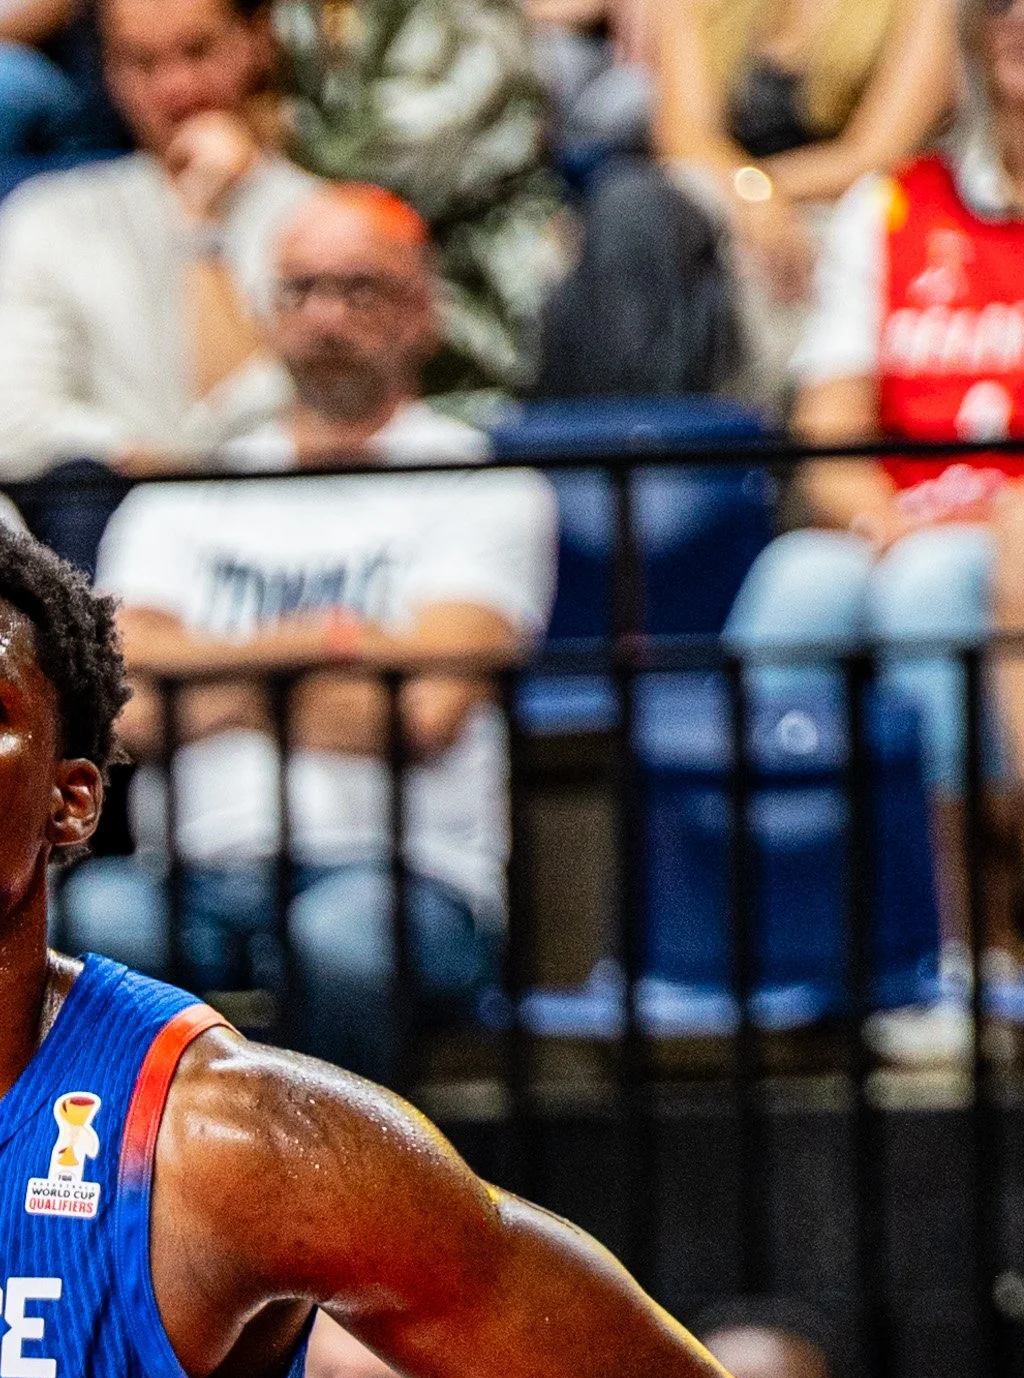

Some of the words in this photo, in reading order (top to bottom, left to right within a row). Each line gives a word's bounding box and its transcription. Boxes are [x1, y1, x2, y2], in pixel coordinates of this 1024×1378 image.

[32, 1188, 70, 1198] WORLD
[74, 1190, 95, 1200] CUP
[29, 1198, 93, 1213] QUALIFIERS
